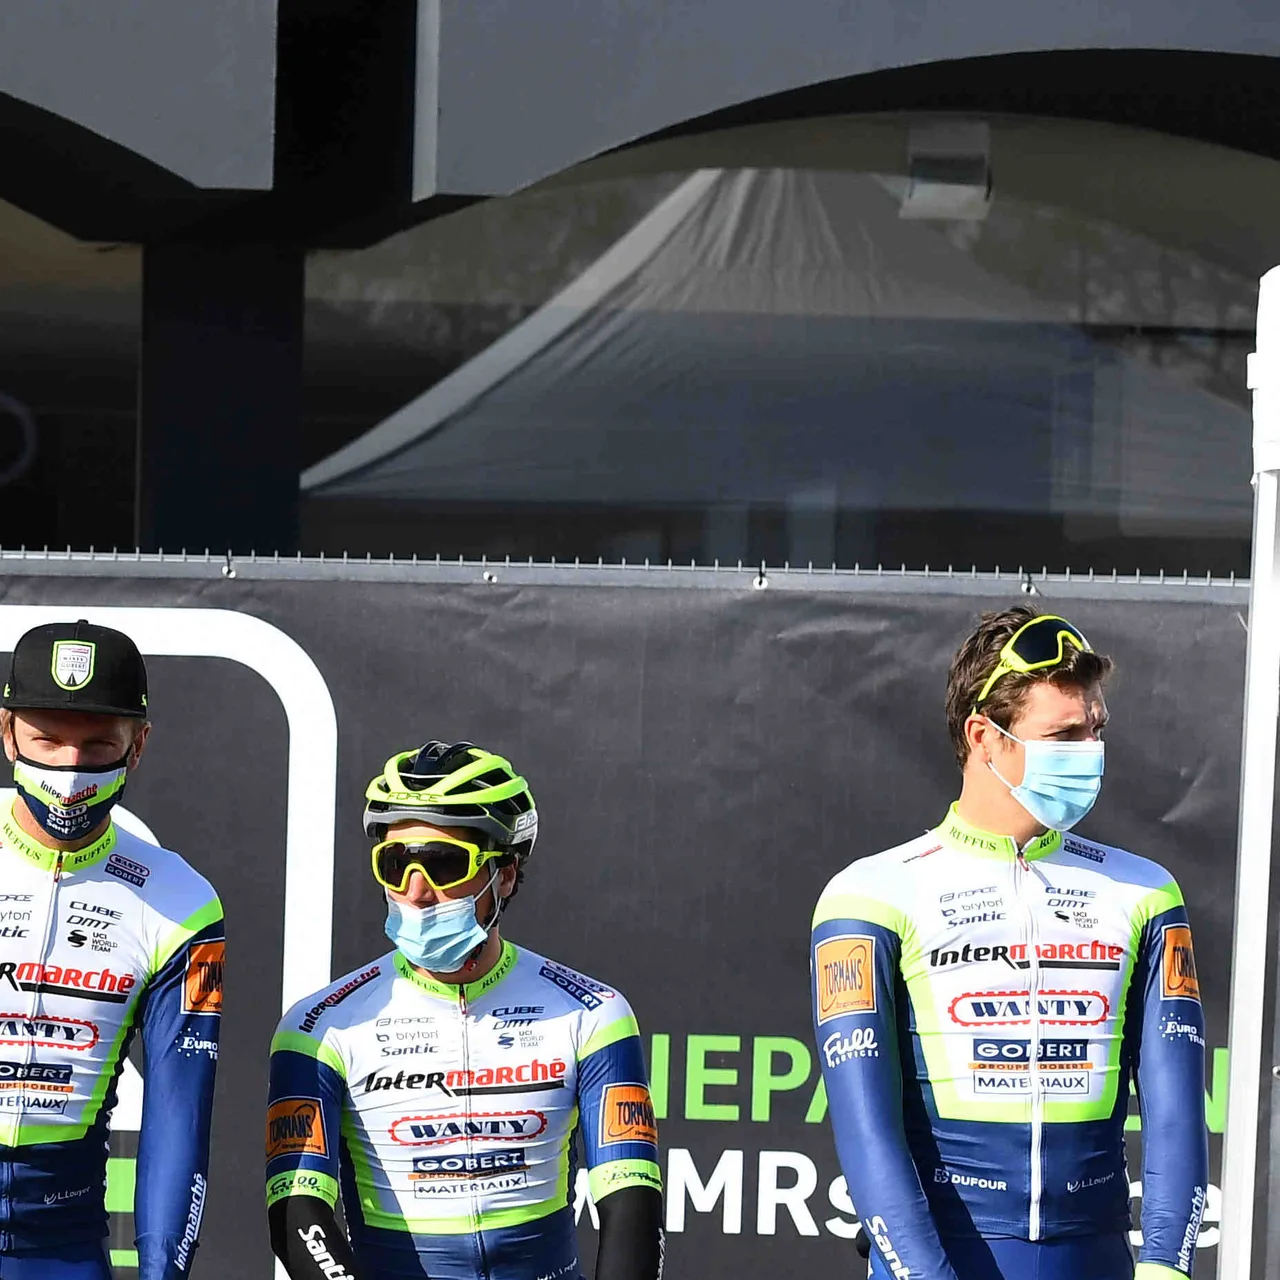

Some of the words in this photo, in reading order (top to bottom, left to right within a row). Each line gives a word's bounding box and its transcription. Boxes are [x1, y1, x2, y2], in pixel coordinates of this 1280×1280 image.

[387, 792, 442, 803] FORCE
[52, 805, 85, 816] WANTY
[48, 814, 89, 827] GOBERT
[2, 822, 42, 861] RUFFUS
[948, 826, 997, 852] RUFFUS
[74, 835, 112, 865] RUFFUS
[107, 865, 145, 887] GOBERT
[1045, 887, 1097, 899] CUBE
[69, 900, 124, 921] CUBE
[962, 898, 1004, 912] bryton
[1047, 899, 1092, 908] DMT
[66, 914, 117, 930] DMT
[947, 911, 1007, 929] Santic
[91, 938, 118, 949] WORLD
[91, 944, 111, 953] TEAM
[930, 939, 1122, 970] Intermarché
[482, 955, 512, 990] RUFFUS
[824, 958, 863, 998] TORMANS
[542, 968, 600, 1009] GOBERT
[298, 964, 381, 1034] Intermarché
[491, 1005, 545, 1017] CUBE
[971, 1000, 1092, 1018] WANTY
[492, 1018, 539, 1030] DMT
[1165, 1021, 1197, 1034] EURO
[181, 1036, 218, 1049] EURO
[380, 1043, 439, 1058] Santic
[824, 1027, 878, 1064] Full
[977, 1043, 1085, 1059] GOBERT
[364, 1058, 567, 1097] Intermarché
[978, 1076, 1086, 1090] MATERIAUX
[270, 1114, 313, 1143] TORMANS
[409, 1118, 528, 1138] WANTY
[417, 1151, 521, 1171] GOBERT
[417, 1176, 523, 1194] MATERIAUX
[951, 1174, 1007, 1191] DUFOUR
